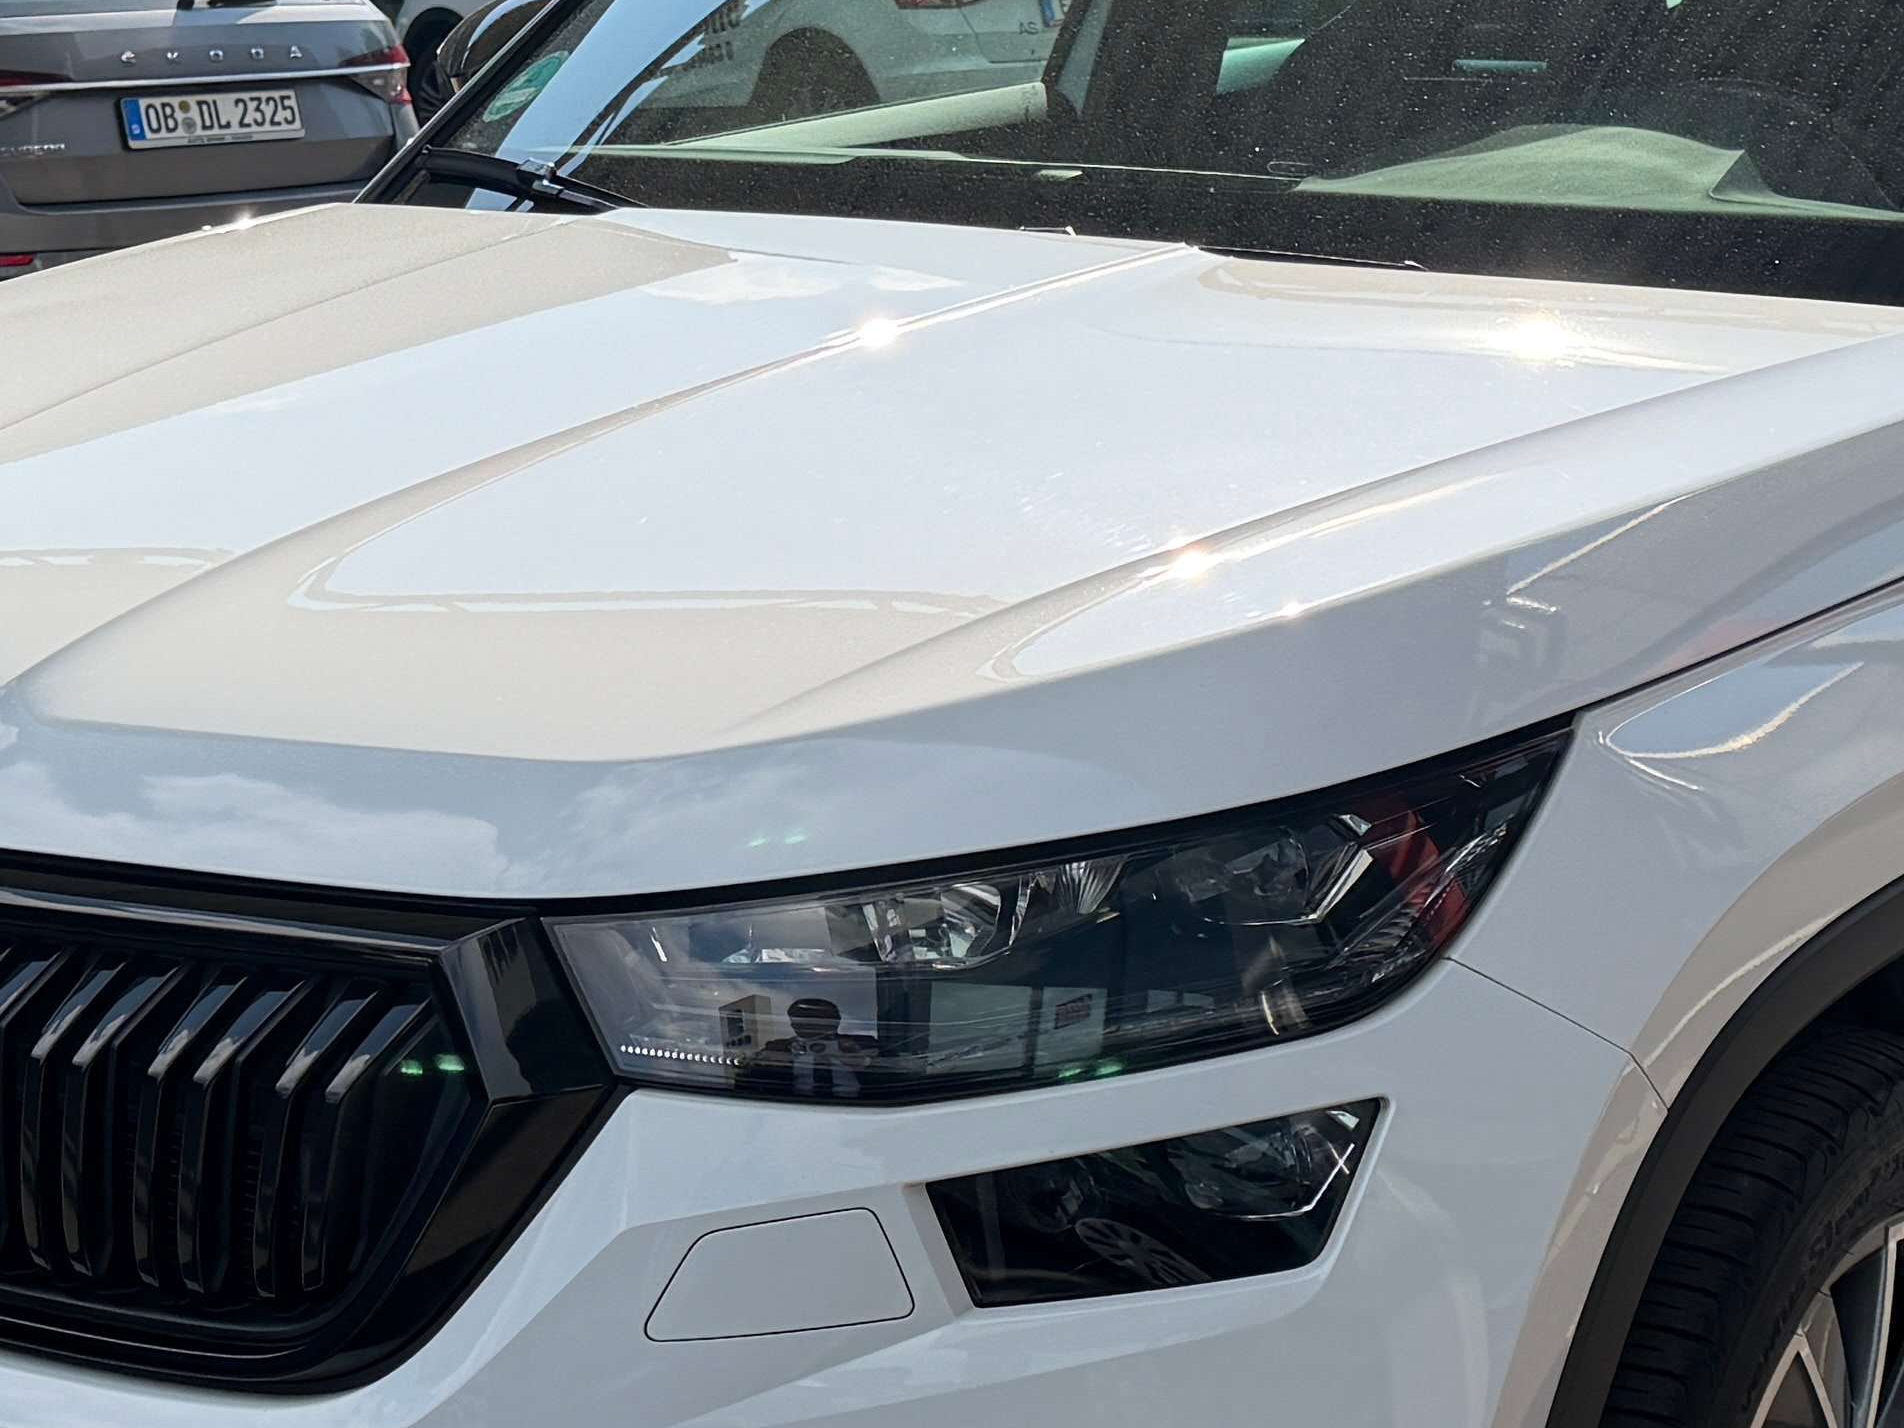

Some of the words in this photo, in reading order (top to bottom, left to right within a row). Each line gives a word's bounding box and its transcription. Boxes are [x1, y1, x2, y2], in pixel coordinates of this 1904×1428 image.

[144, 101, 179, 134] OB
[196, 99, 232, 131] DL
[234, 94, 297, 129] 2325
